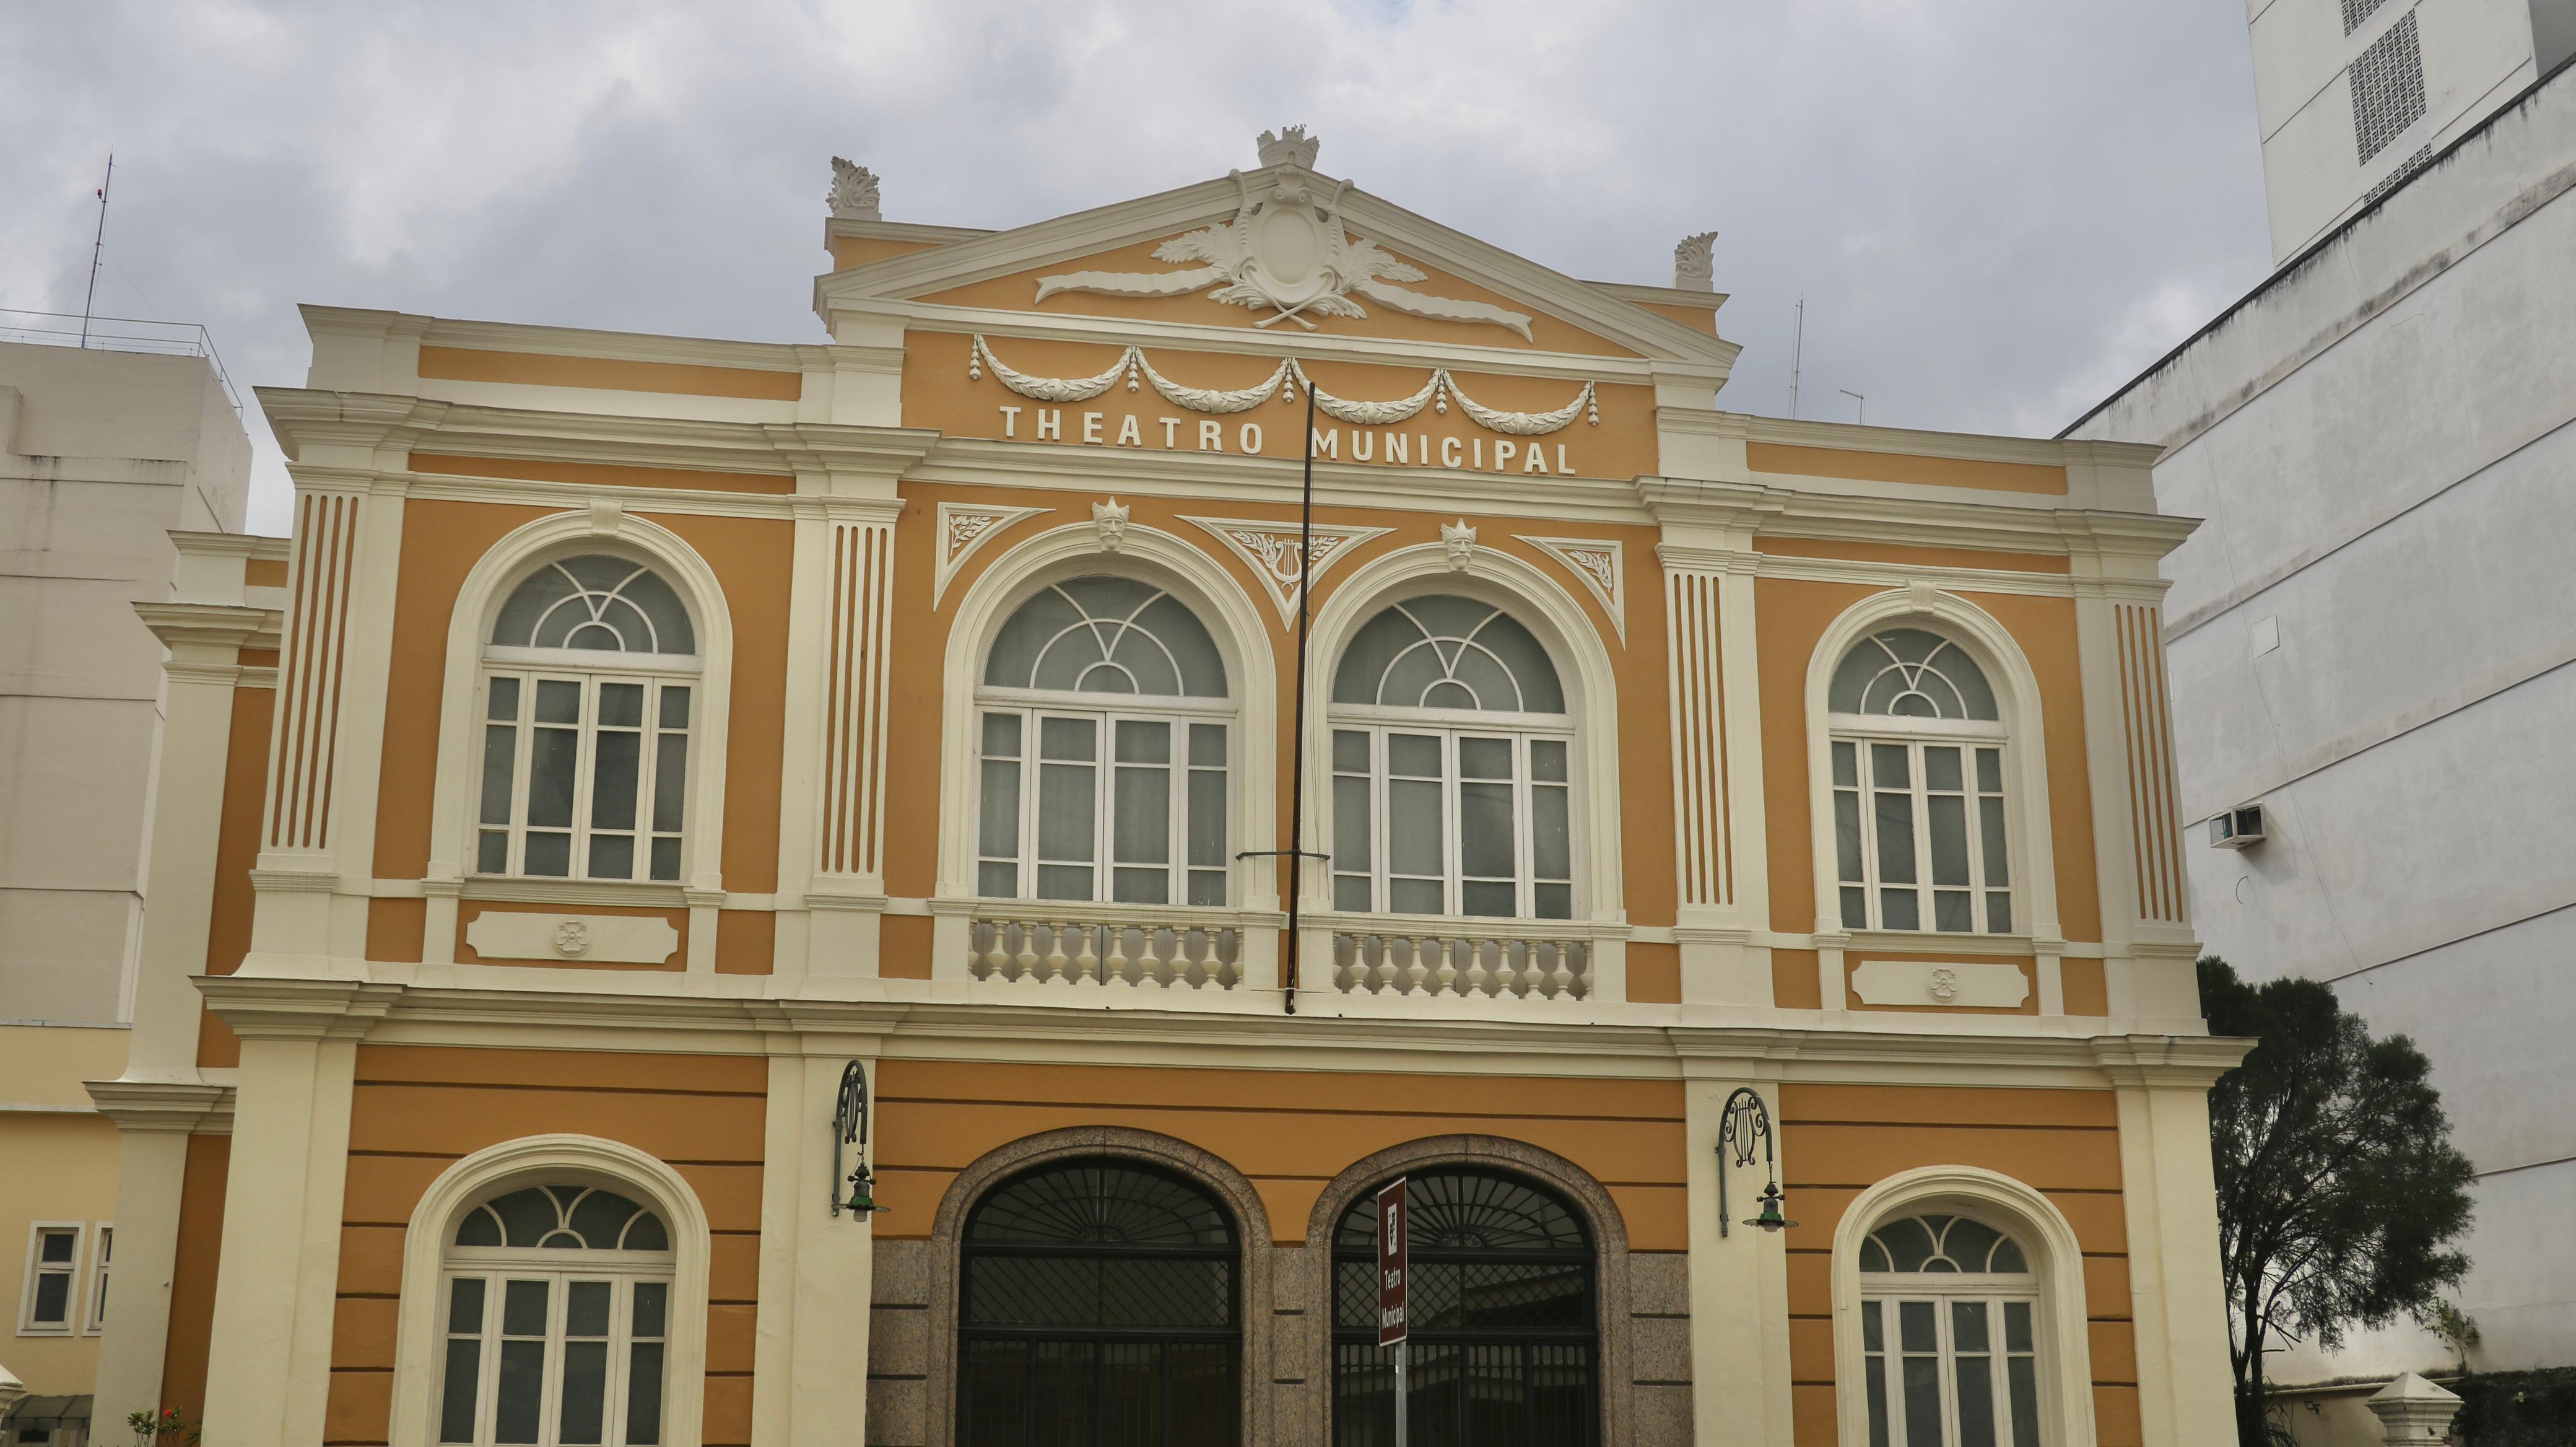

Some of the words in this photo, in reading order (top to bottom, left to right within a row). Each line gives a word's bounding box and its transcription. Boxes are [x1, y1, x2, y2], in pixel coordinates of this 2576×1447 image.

[999, 406, 1263, 455] THEATRO
[1311, 427, 1576, 475] MUNICIPAL
[1385, 1267, 1401, 1291] Teatro
[1382, 1301, 1404, 1329] Municipal
